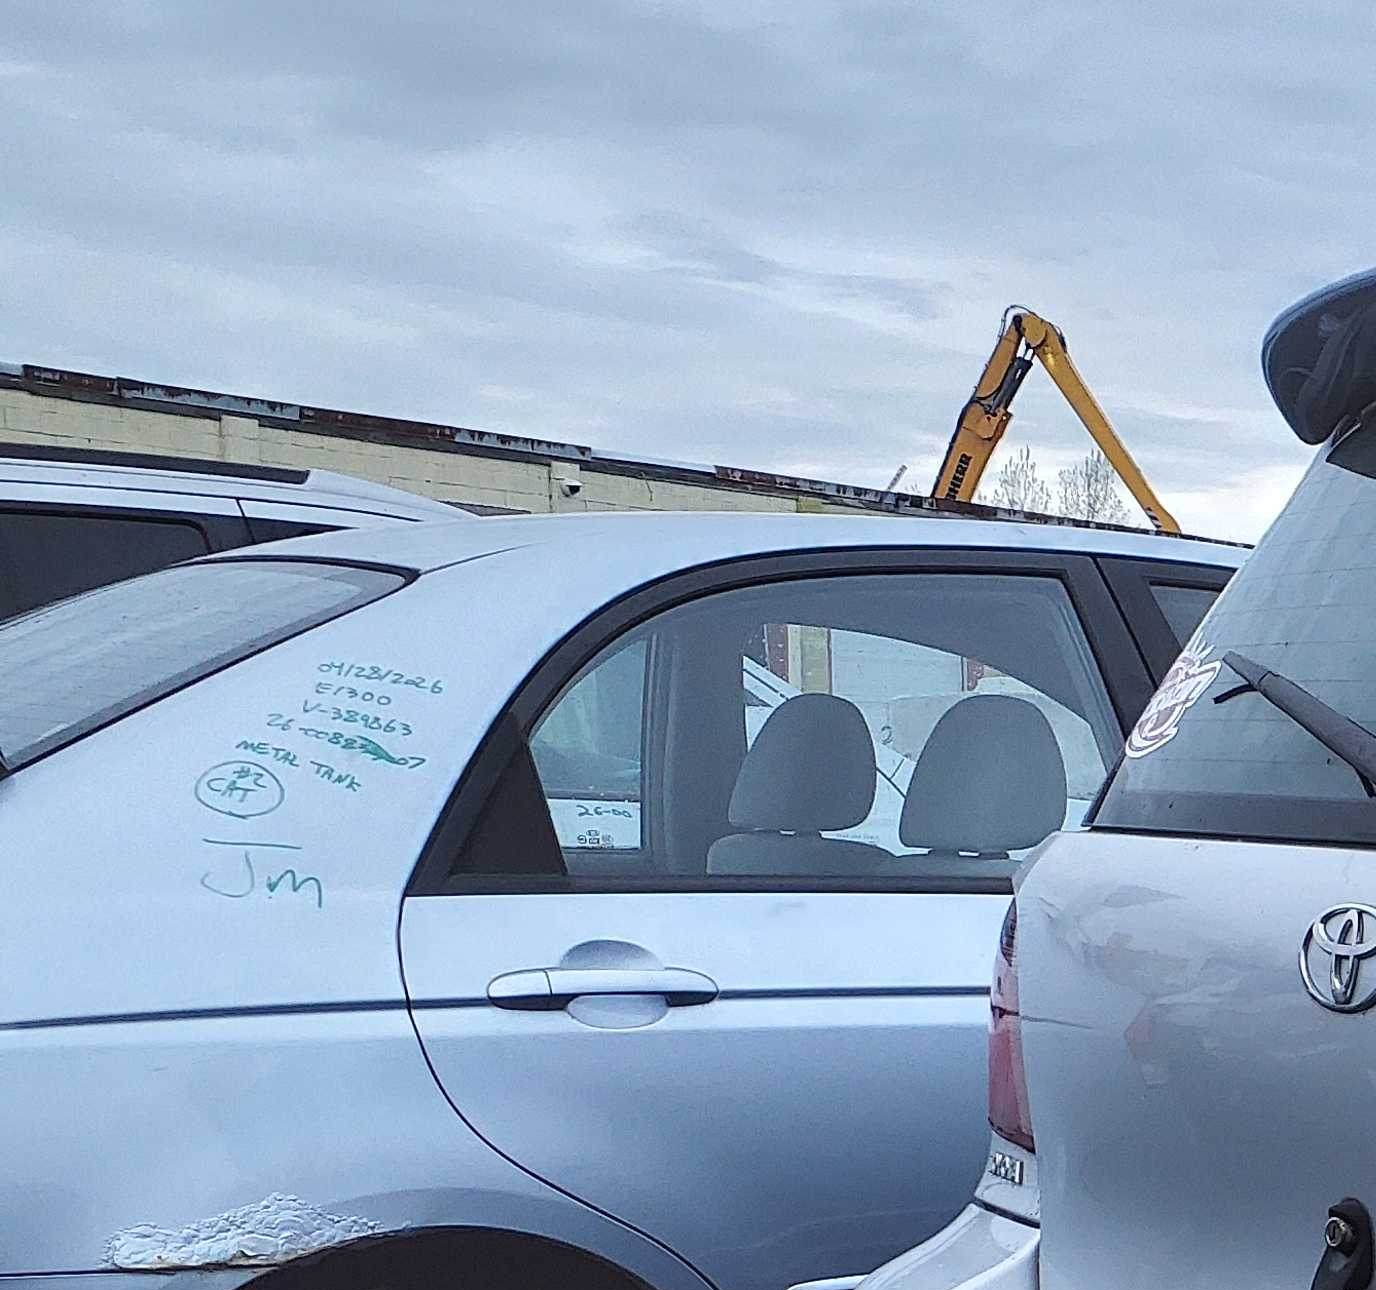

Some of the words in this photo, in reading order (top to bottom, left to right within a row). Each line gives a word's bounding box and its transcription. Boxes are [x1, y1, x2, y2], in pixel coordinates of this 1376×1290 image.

[317, 661, 443, 694] 04/28/2026
[235, 739, 300, 768] METAL
[309, 759, 362, 792] TANK
[206, 777, 257, 802] CAT
